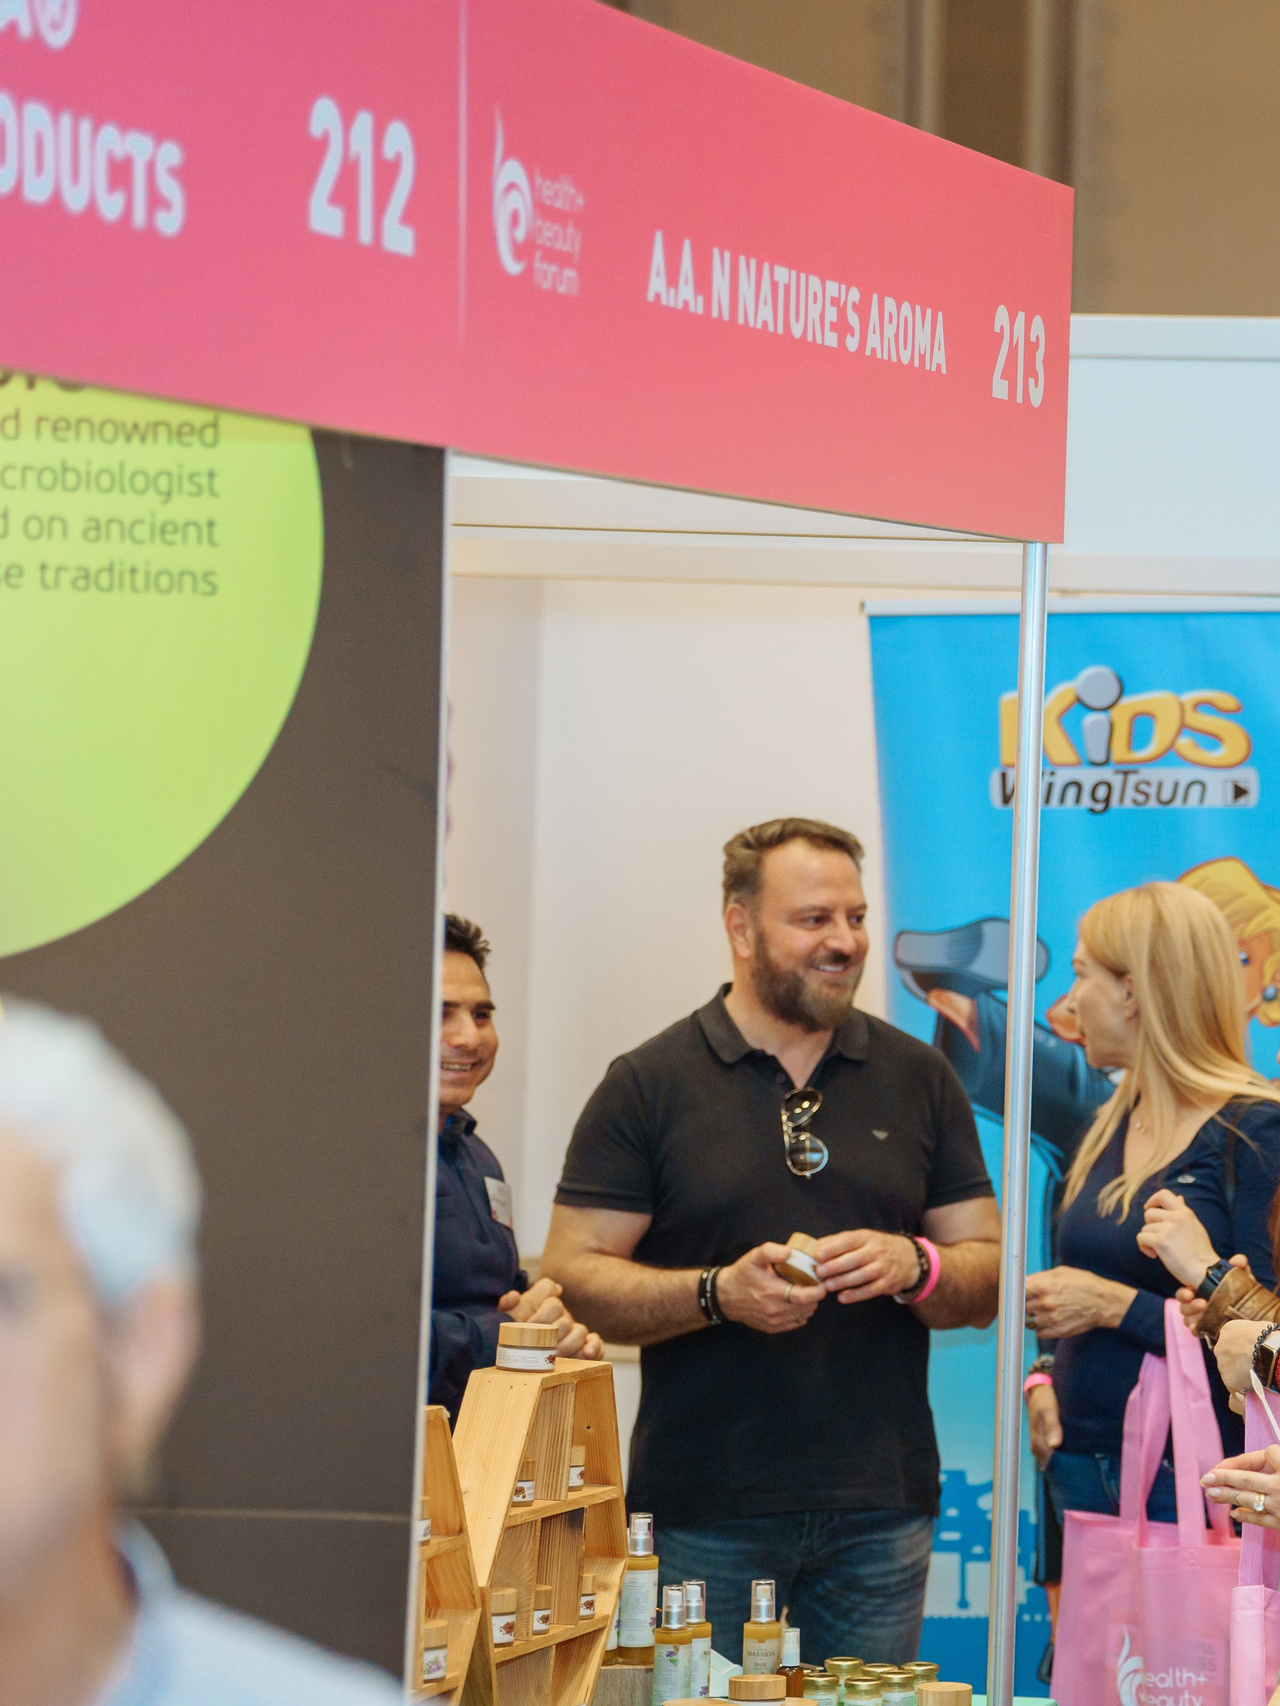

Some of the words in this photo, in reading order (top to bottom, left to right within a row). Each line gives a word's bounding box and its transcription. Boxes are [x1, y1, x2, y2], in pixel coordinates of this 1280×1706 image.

[308, 97, 415, 257] 212
[534, 251, 579, 296] forum
[646, 230, 704, 315] A.A.
[711, 247, 731, 321] N
[737, 254, 861, 354] NATURE'S
[864, 292, 947, 375] AROMA
[991, 304, 1046, 408] 213
[35, 411, 219, 448] renowned
[1, 459, 219, 505] crobiologist
[23, 514, 67, 542] on
[82, 511, 219, 548] ancient
[40, 560, 219, 597] traditions
[1143, 1667, 1208, 1689] ealth+
